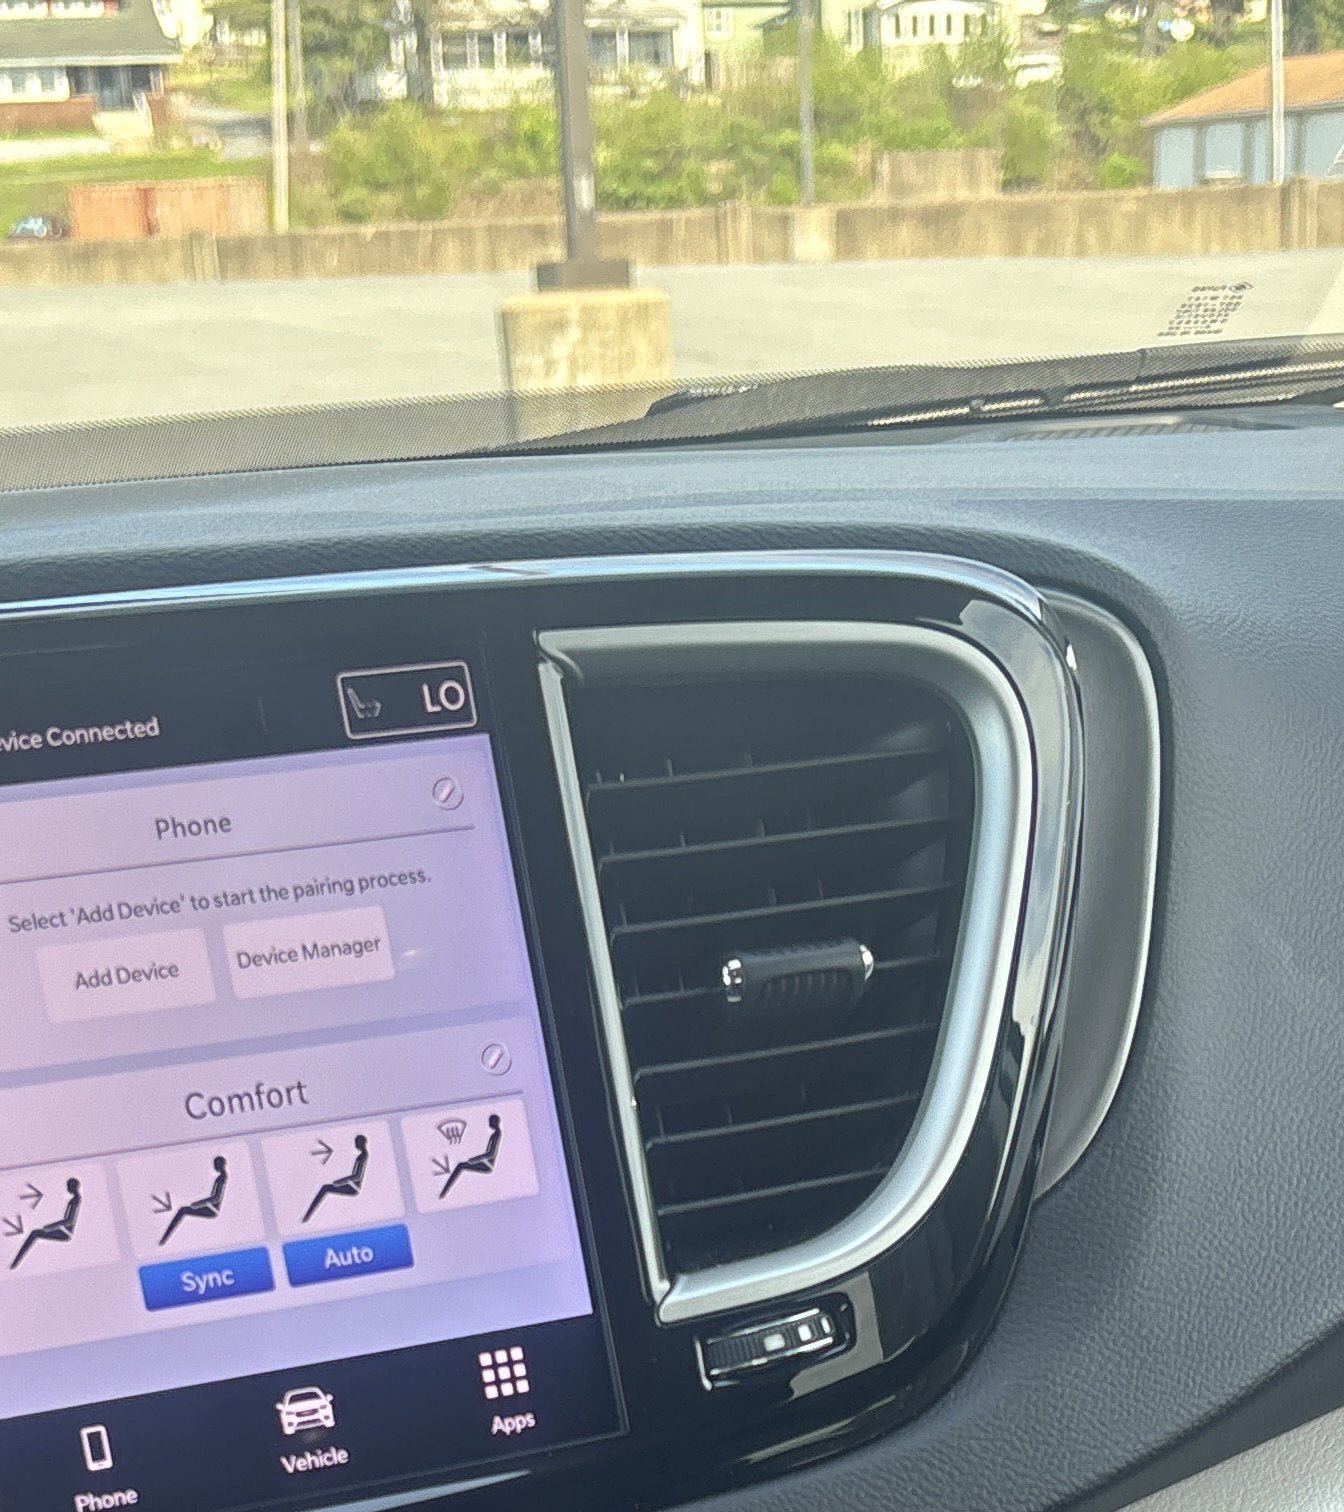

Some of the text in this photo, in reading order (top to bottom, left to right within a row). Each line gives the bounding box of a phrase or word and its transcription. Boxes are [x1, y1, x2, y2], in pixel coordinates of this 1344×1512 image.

[423, 680, 466, 714] LO
[47, 717, 160, 749] Connected
[155, 811, 234, 841] Phone
[8, 868, 432, 934] Select 'Add Device' to start the pairing process.
[237, 934, 382, 970] Device Manager
[74, 959, 181, 991] Add Device
[184, 1079, 310, 1122] Comfort
[324, 1242, 375, 1270] Auto
[181, 1266, 235, 1294] Sync
[490, 1410, 537, 1436] Apps
[280, 1444, 350, 1474] Vehicle
